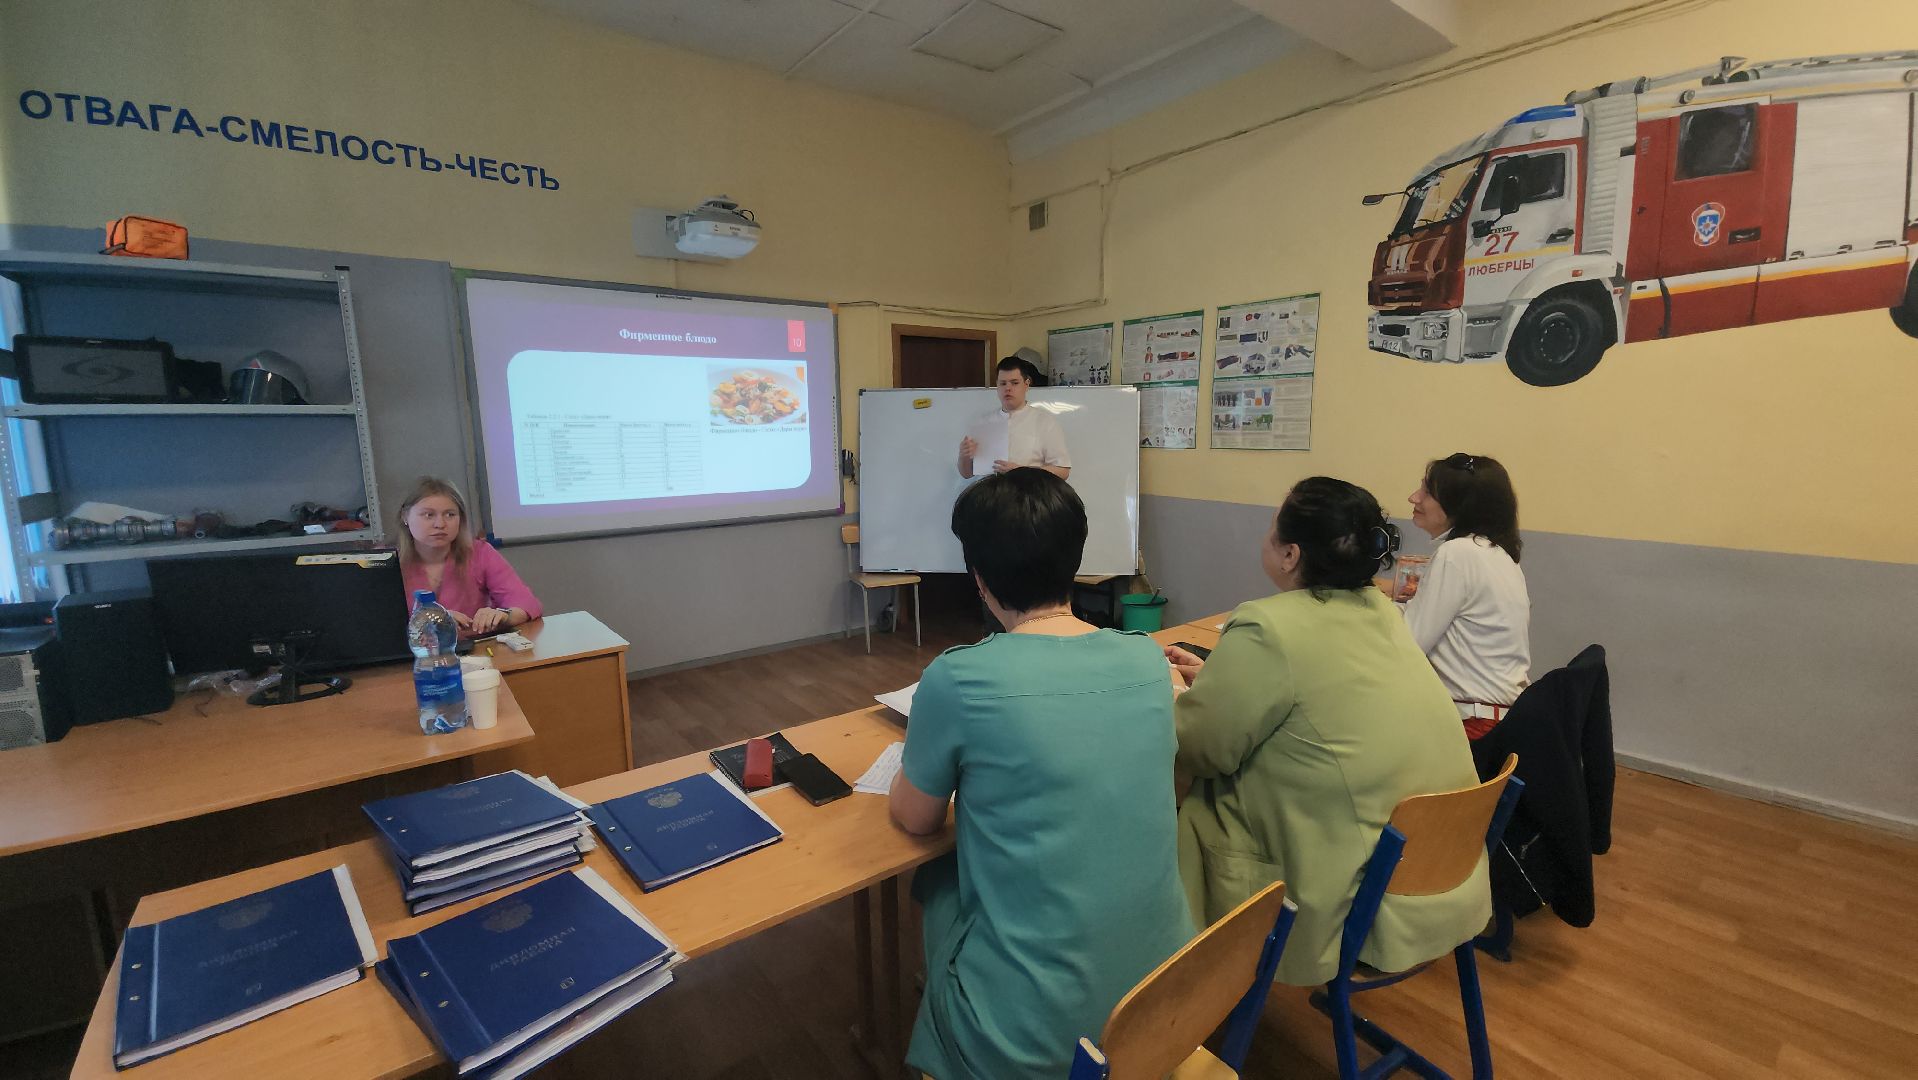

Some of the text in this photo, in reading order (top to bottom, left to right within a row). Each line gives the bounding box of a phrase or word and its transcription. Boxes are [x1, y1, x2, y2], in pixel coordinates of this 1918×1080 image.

[19, 89, 561, 191] ОТВАГА-СМЕЛОСТЬ-ЧЕСТЬ
[1484, 231, 1520, 256] 27
[1468, 258, 1535, 277] ЛЮБЕРЦЫ
[619, 328, 717, 344] Фирменное блюдо
